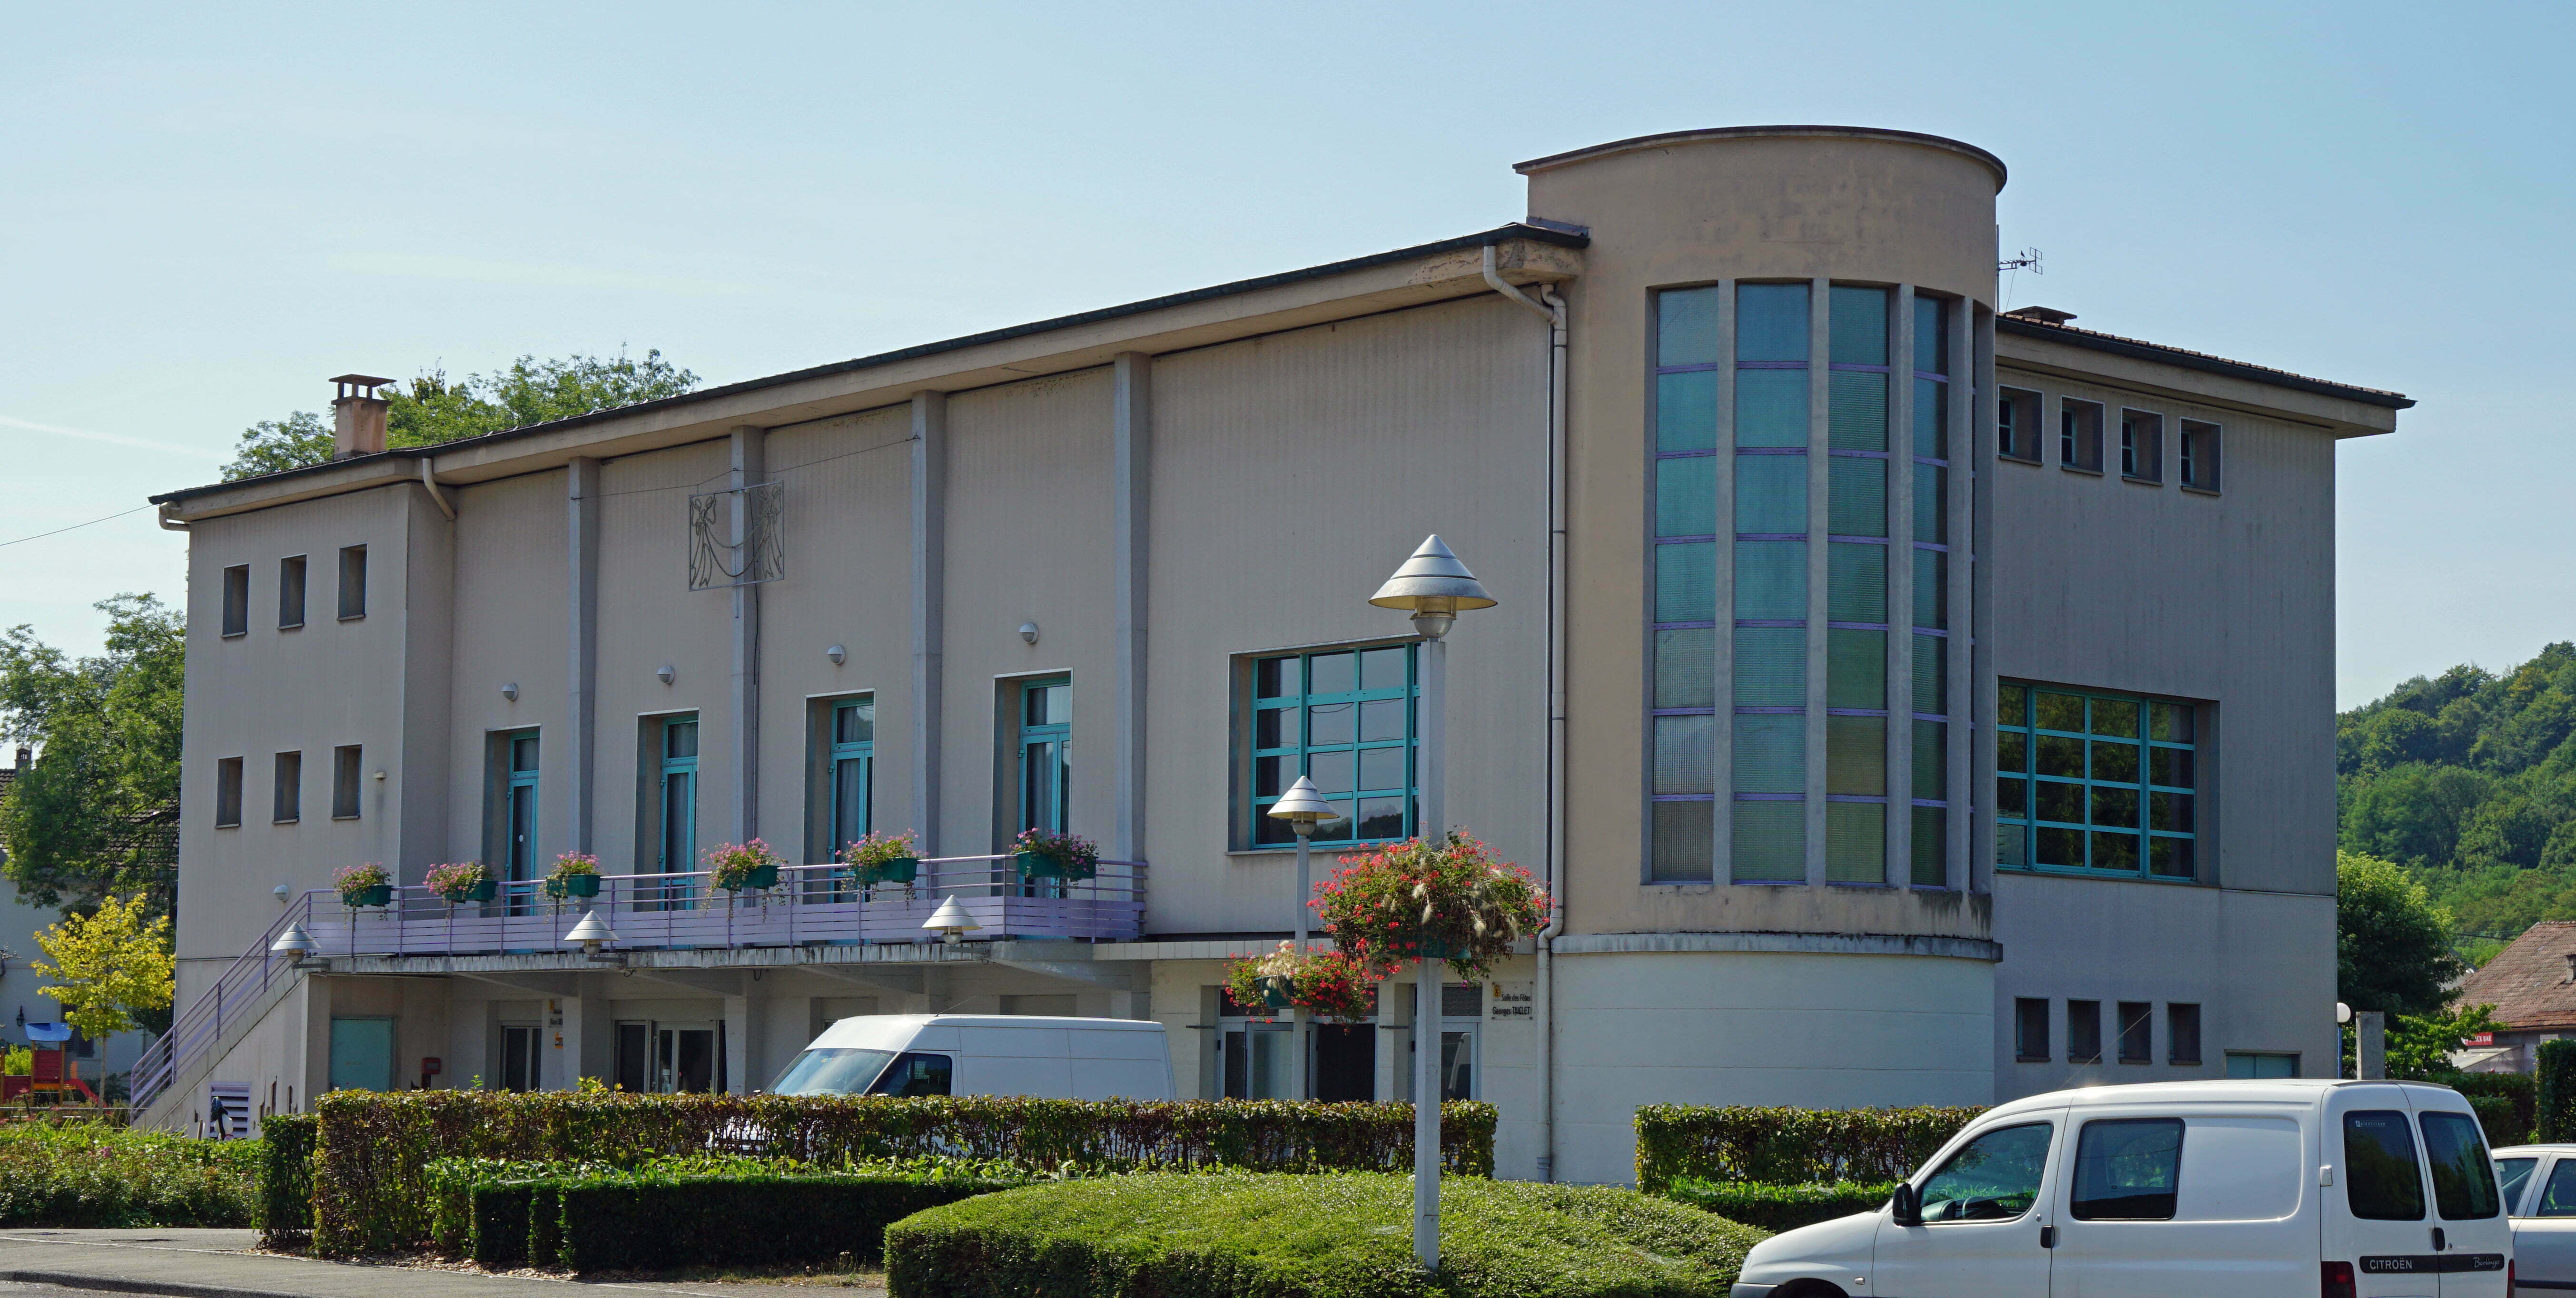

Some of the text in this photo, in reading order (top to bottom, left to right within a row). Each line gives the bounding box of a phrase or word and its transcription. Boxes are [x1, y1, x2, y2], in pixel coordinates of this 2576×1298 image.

[1492, 1006, 1511, 1016] Georges
[2369, 1257, 2412, 1269] CITROËN
[2473, 1256, 2500, 1268] Berlingo
